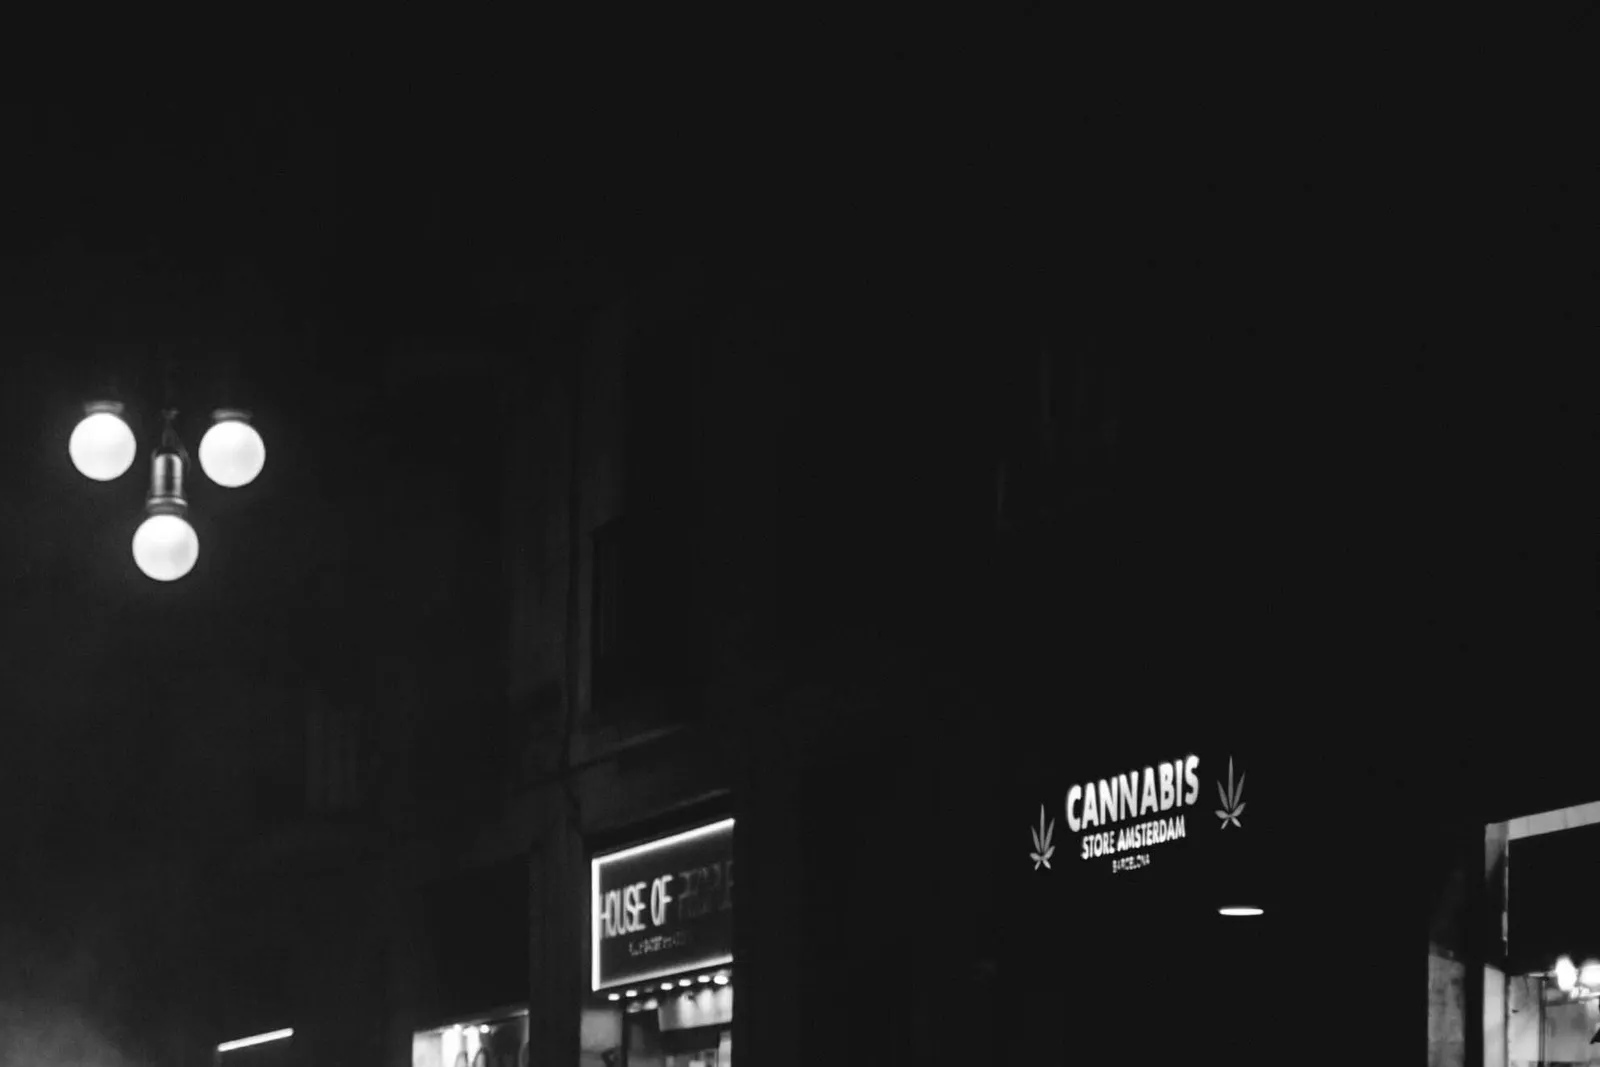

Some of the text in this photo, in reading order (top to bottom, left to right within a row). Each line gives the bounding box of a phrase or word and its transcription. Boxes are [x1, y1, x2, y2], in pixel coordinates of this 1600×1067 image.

[1066, 754, 1200, 832] CANNABIS
[1081, 814, 1186, 860] STORE AMSTERDAM
[600, 880, 648, 939] HOUSE
[651, 873, 675, 927] OF
